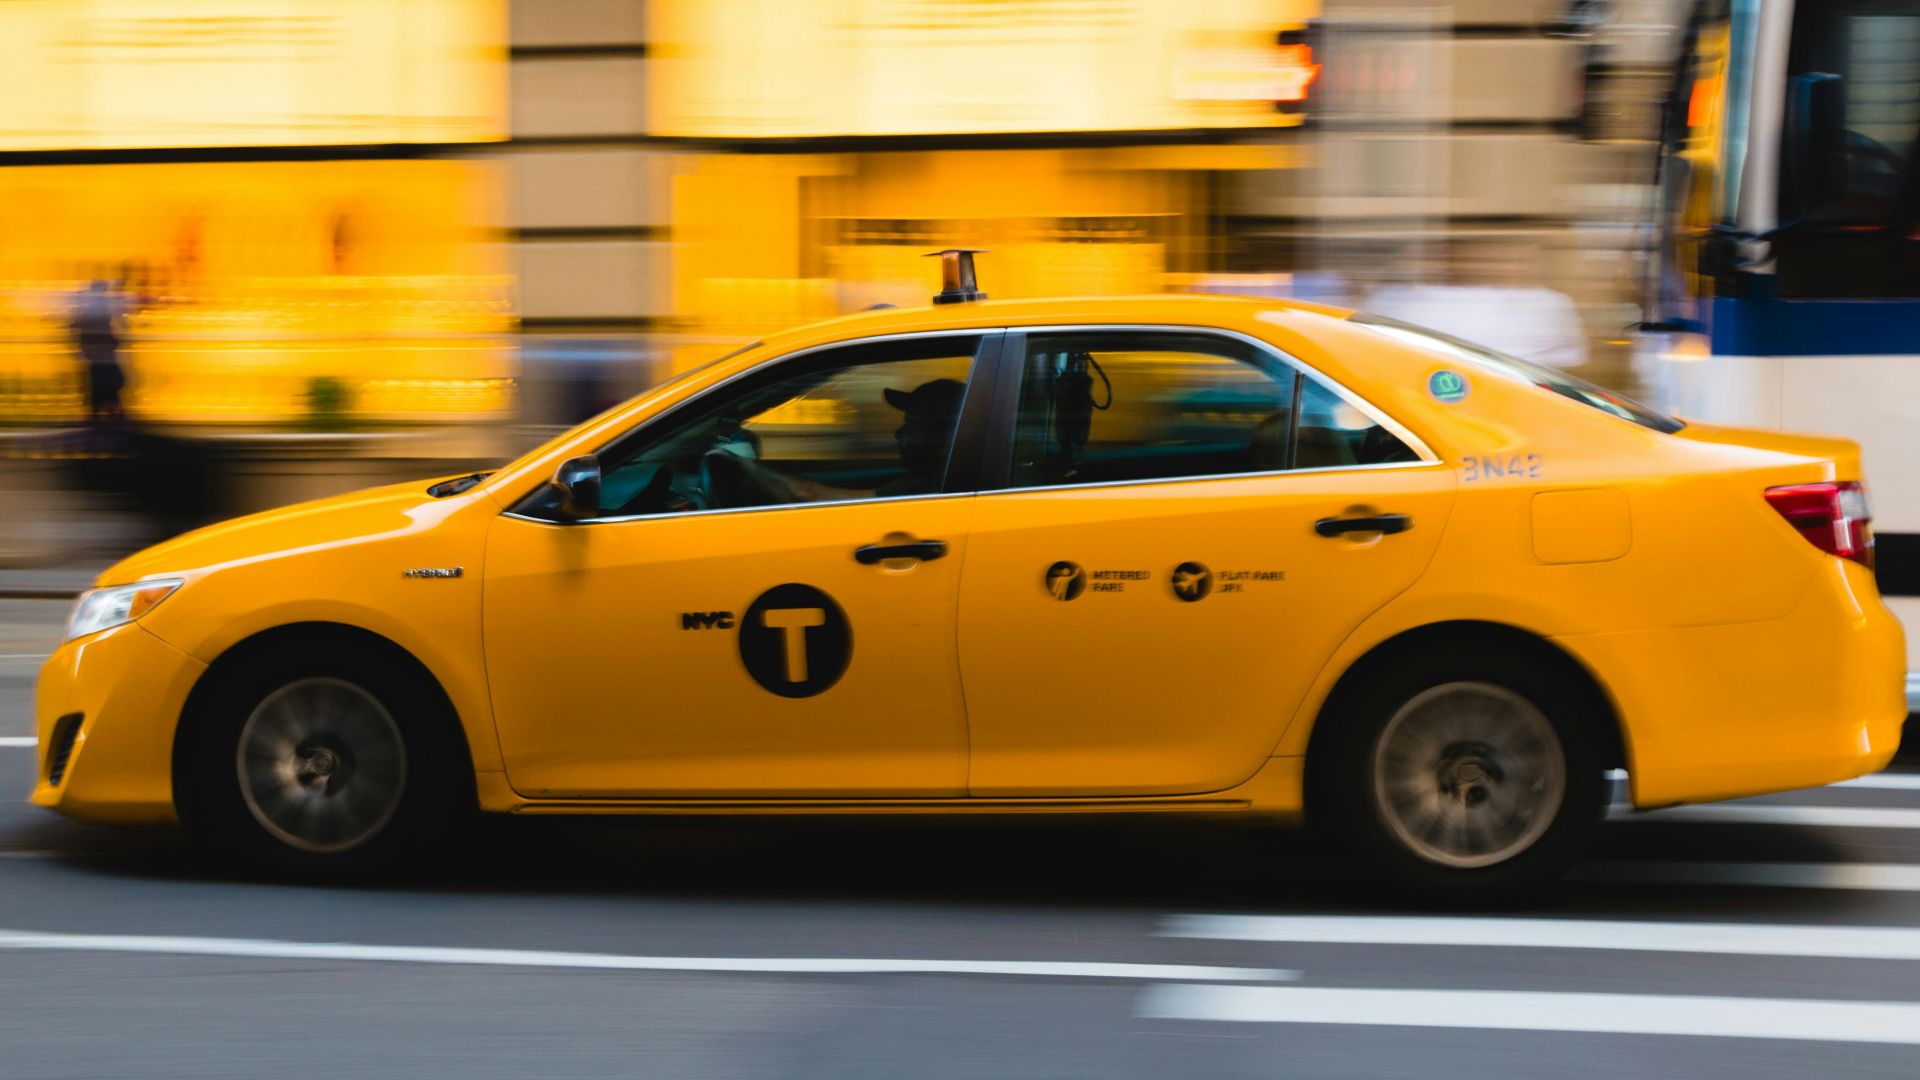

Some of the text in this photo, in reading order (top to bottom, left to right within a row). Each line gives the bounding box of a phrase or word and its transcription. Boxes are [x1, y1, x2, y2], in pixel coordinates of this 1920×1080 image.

[1462, 453, 1543, 481] 3N42
[681, 608, 826, 683] NYC T
